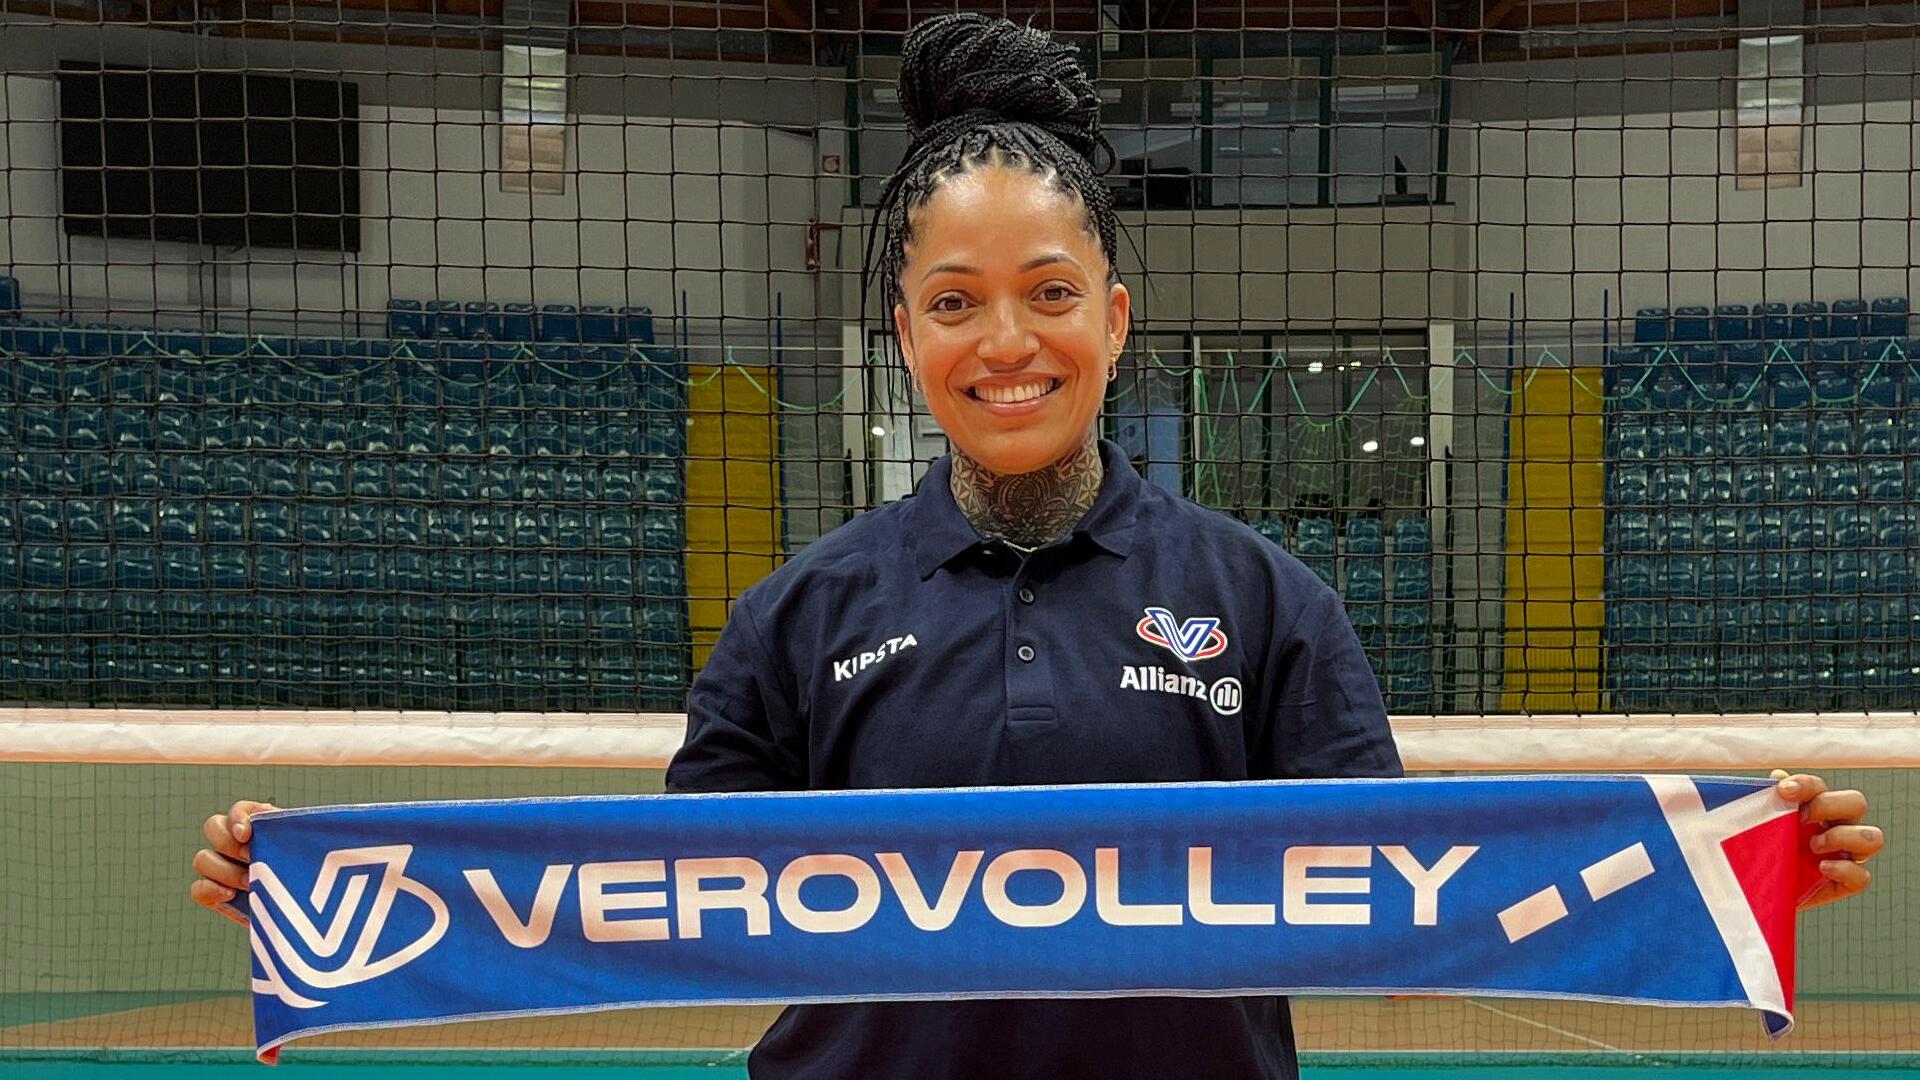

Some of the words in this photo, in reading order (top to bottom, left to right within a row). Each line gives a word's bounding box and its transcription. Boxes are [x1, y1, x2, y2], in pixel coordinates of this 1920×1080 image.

[833, 634, 918, 681] KIPSTA
[1119, 665, 1208, 701] Allianz
[463, 845, 1480, 948] VEROVOLLEY
